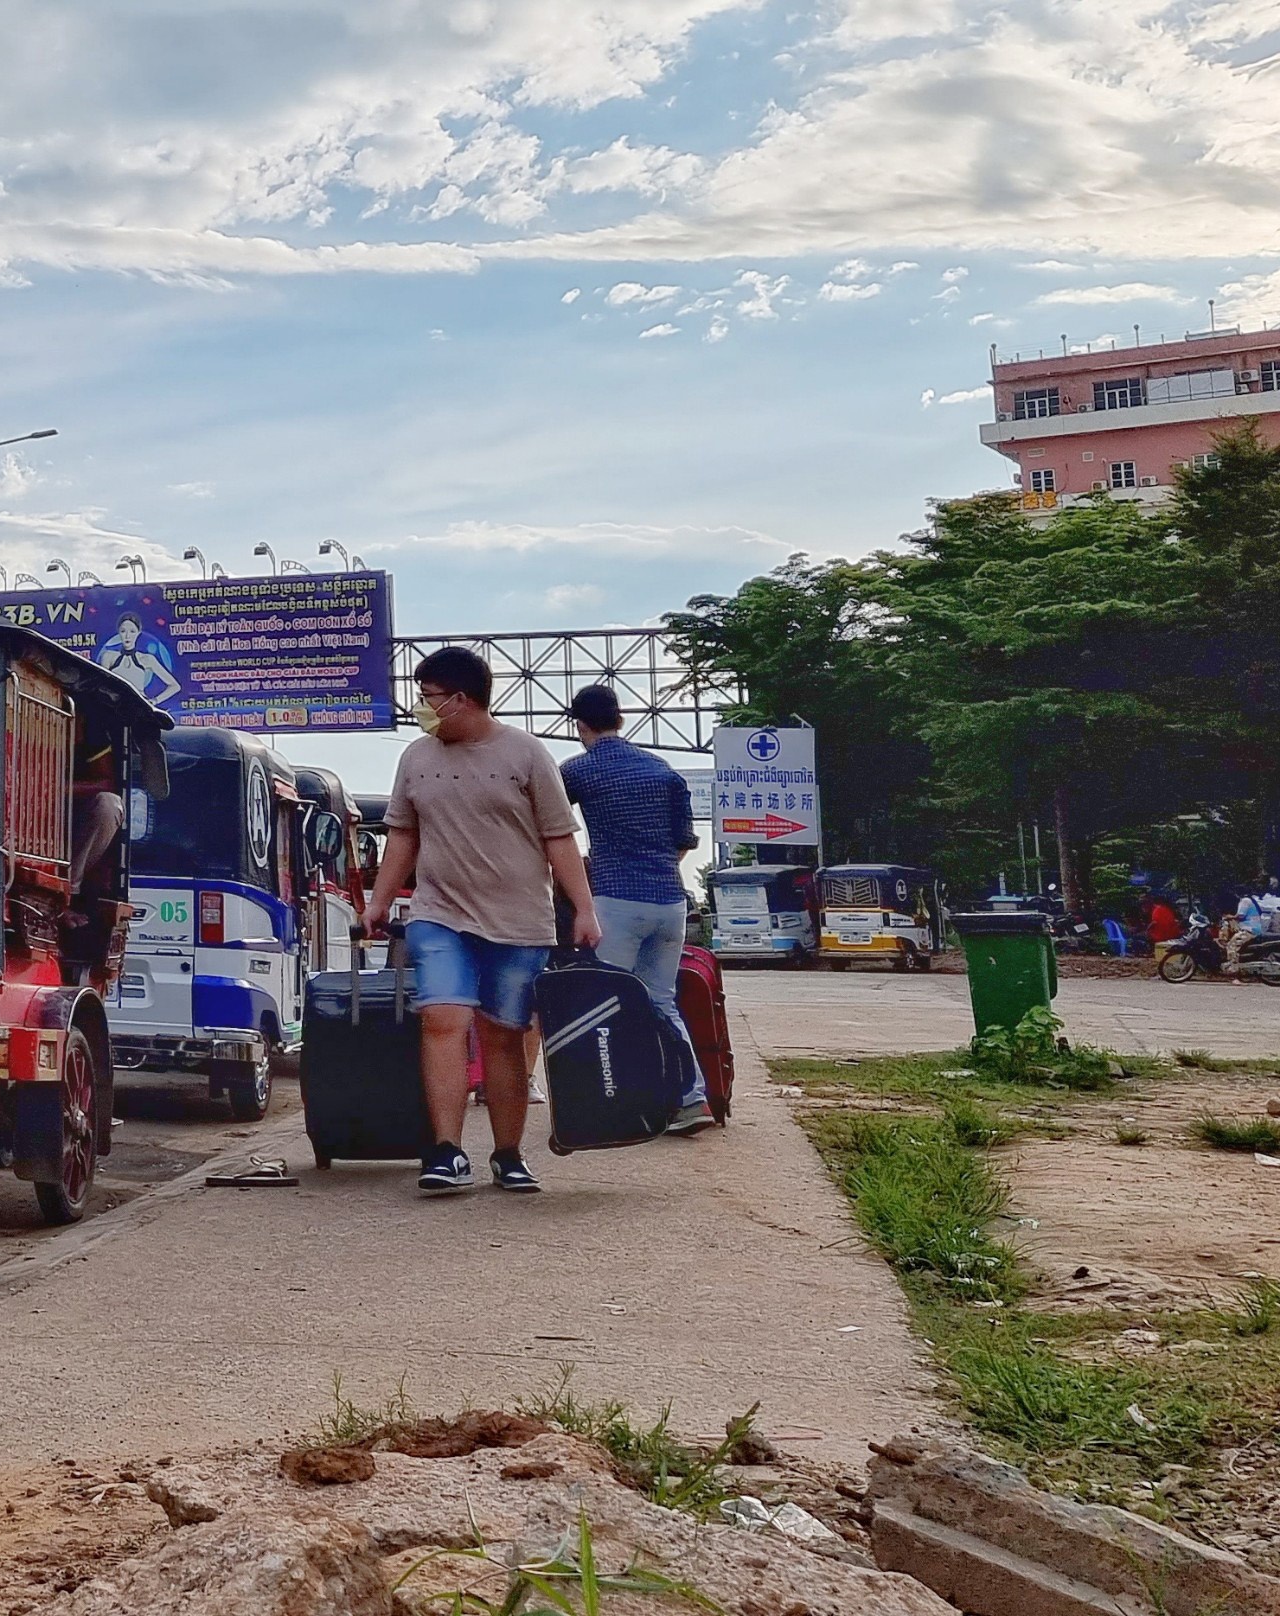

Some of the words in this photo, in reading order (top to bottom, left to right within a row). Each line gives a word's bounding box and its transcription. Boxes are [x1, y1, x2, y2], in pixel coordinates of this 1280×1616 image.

[292, 618, 316, 630] GOM
[232, 638, 251, 650] Hoa
[280, 637, 297, 648] cao
[718, 791, 813, 811] 木牌市场诊所
[160, 901, 188, 923] 05
[596, 1027, 617, 1098] Panasonic
